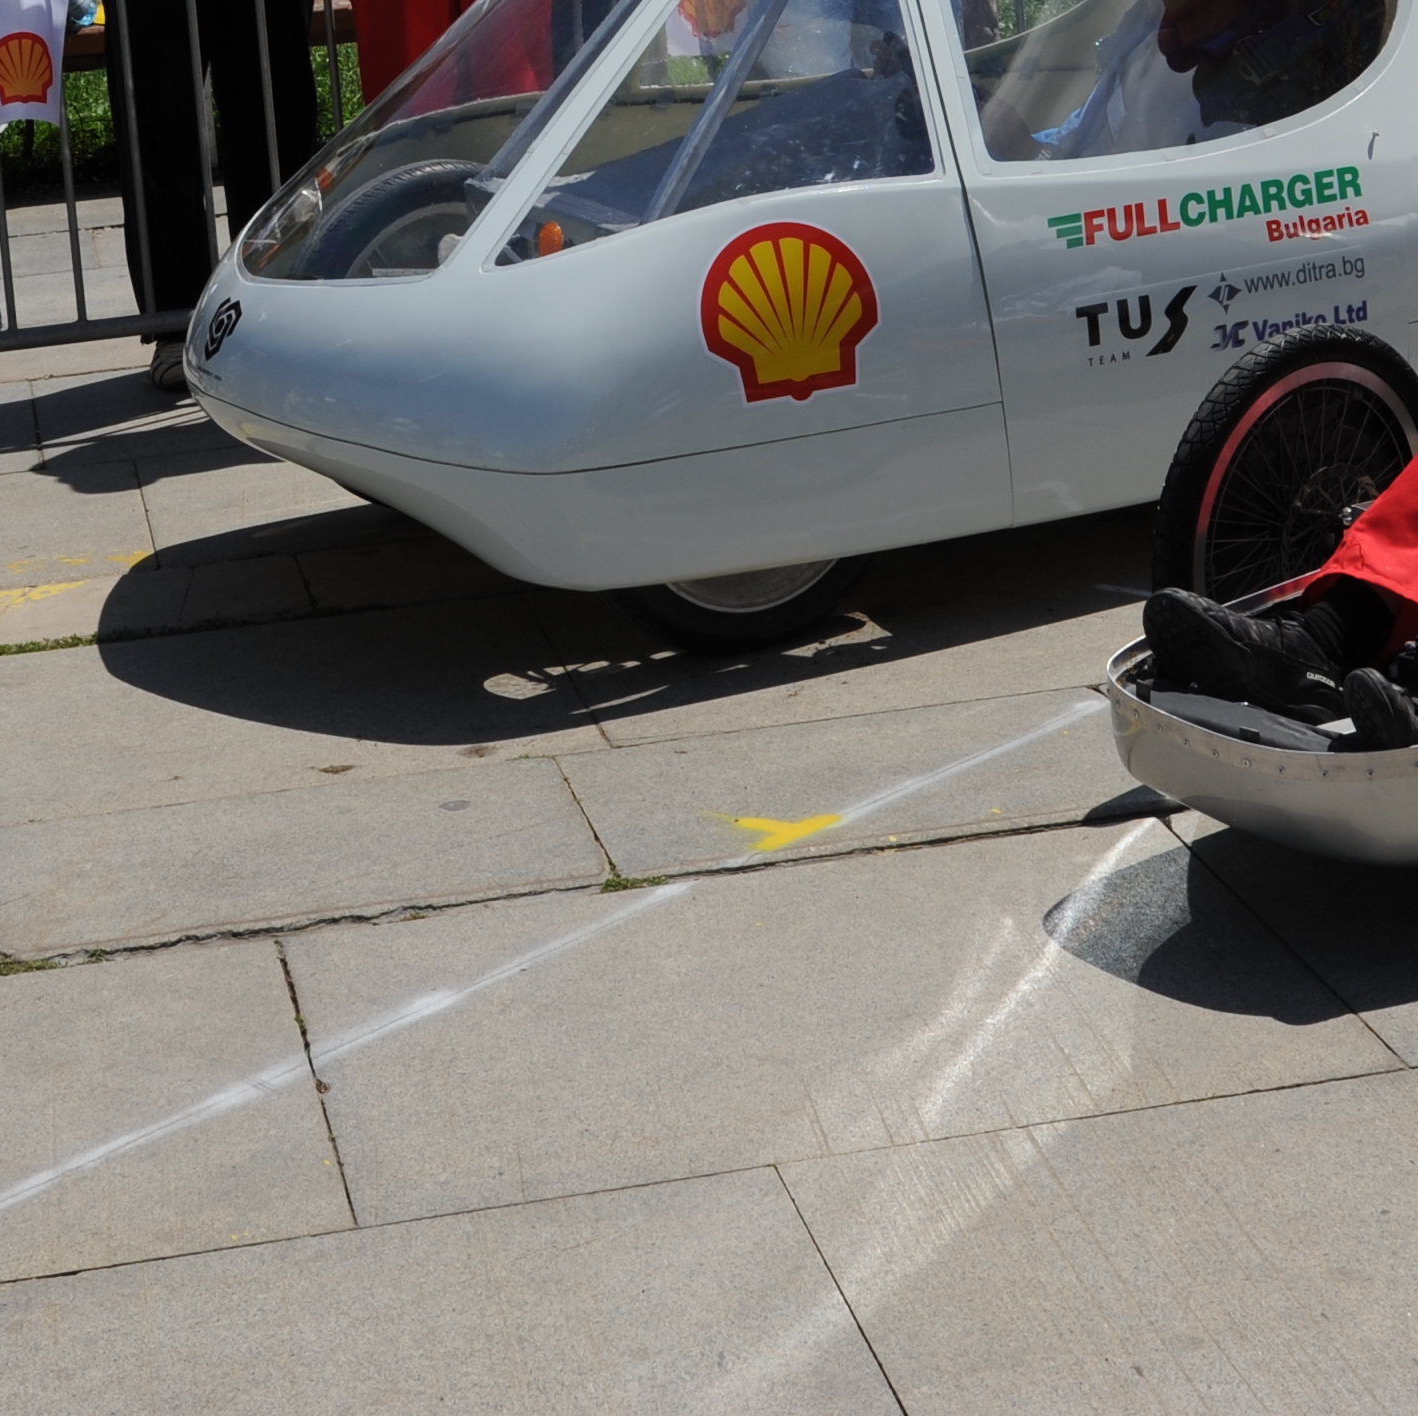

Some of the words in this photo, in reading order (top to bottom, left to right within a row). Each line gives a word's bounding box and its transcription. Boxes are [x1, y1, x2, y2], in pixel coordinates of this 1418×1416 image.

[1084, 166, 1363, 246] FULLCHARGER
[1266, 206, 1369, 242] Bulgaria
[1244, 256, 1366, 294] www.ditra.bg
[1333, 299, 1369, 326] Ltd
[1088, 350, 1131, 368] TEAM
